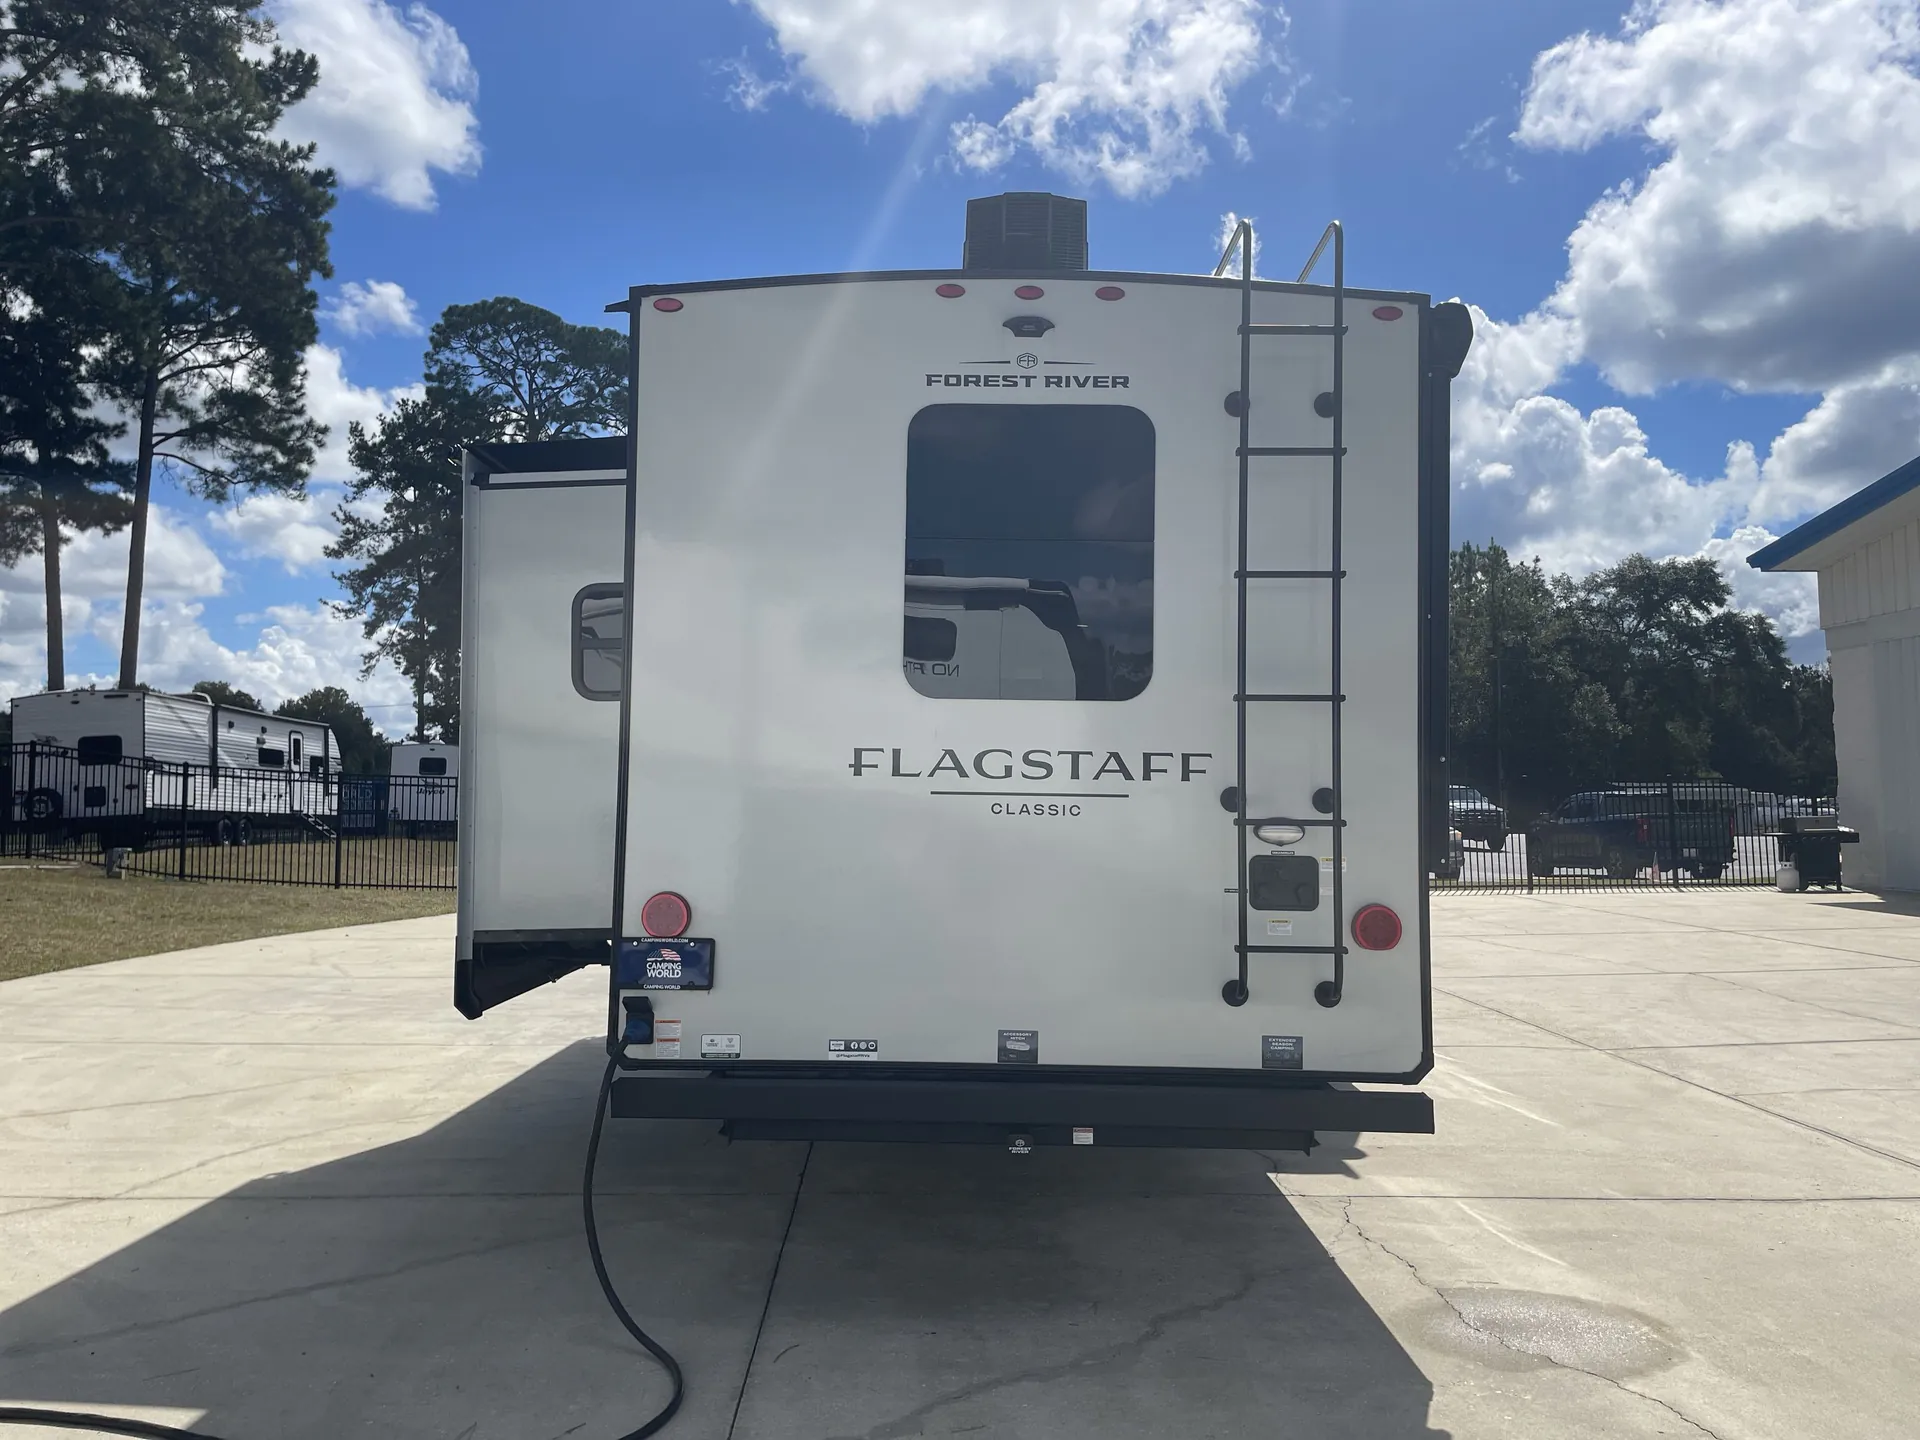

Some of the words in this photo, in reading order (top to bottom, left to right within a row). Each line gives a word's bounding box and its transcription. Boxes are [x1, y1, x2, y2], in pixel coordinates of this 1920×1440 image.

[925, 373, 1037, 388] FOREST
[1044, 375, 1130, 389] RIVER
[848, 747, 1213, 782] FLAGSTAFF
[990, 802, 1082, 817] CLASSIC
[646, 962, 682, 970] CAMPING
[647, 969, 682, 978] WORLD
